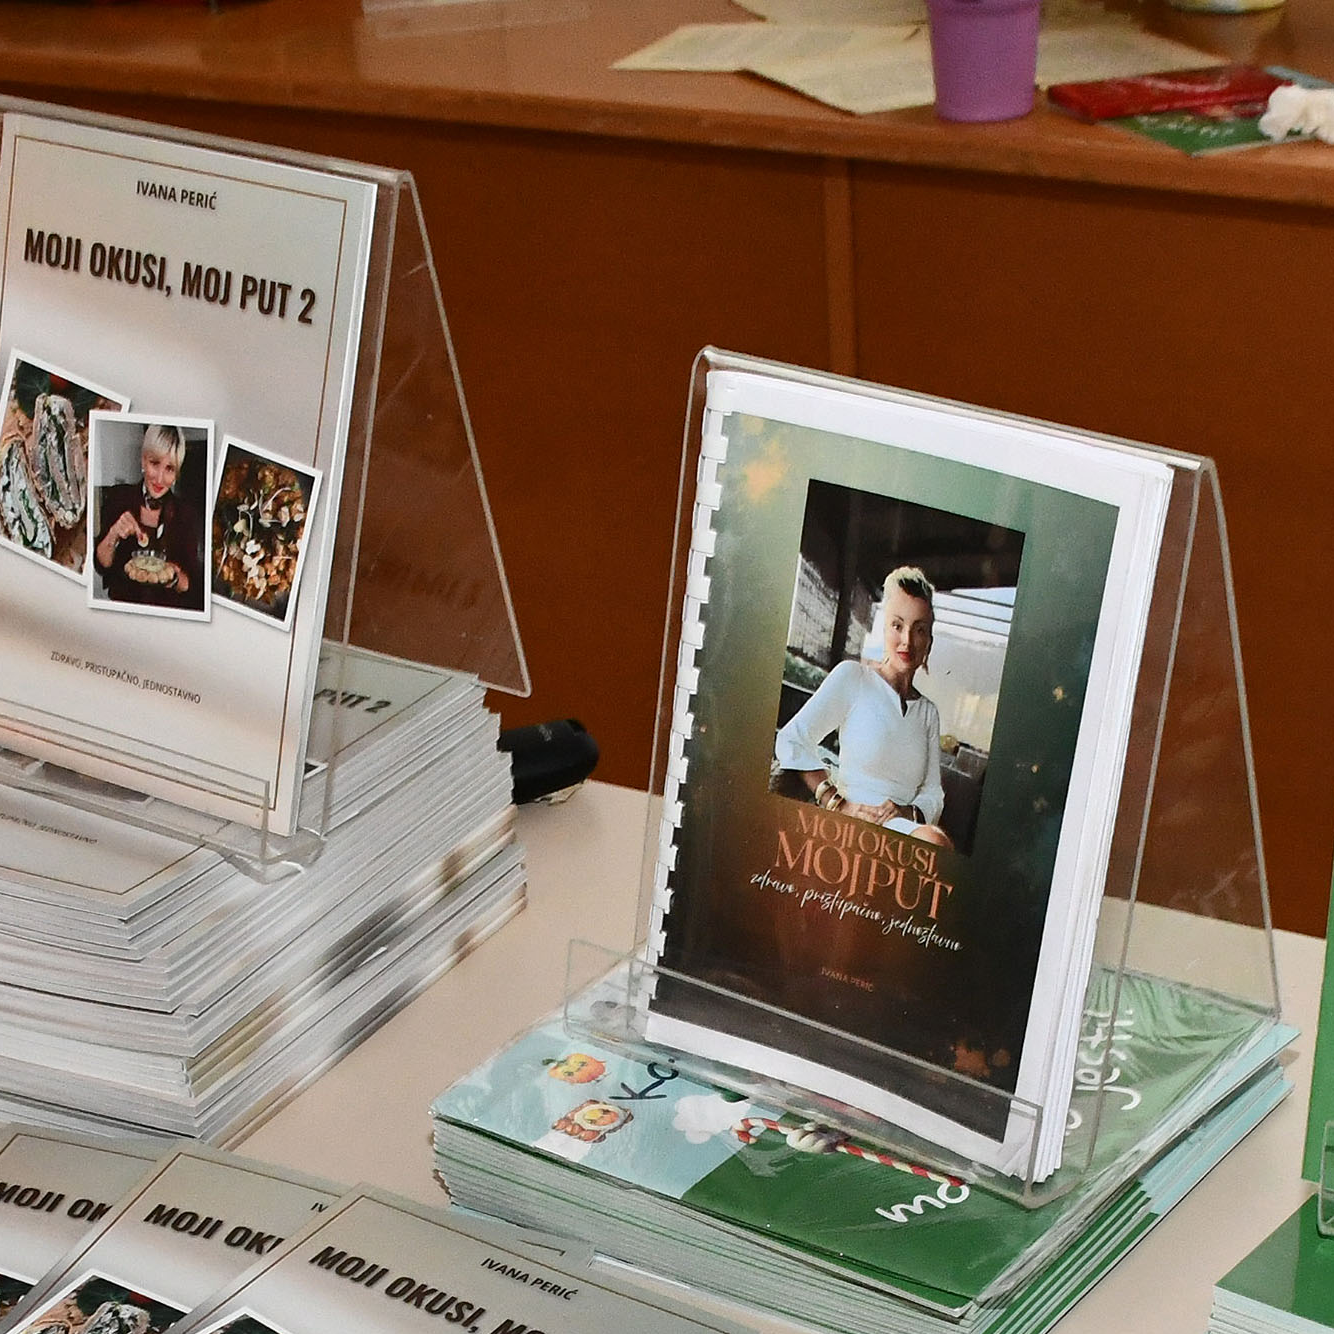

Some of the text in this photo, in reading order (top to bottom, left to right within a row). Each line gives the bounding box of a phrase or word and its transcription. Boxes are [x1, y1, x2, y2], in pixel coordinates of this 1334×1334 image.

[136, 180, 217, 210] IVANA PERIĆ
[23, 228, 316, 325] MOJI OKUSI, MOJ PUT 2
[50, 651, 83, 670] ZDRAVO,
[142, 679, 201, 704] JEDNOSTAVNO
[365, 700, 391, 713] 2
[795, 808, 855, 848] MOJI
[775, 830, 953, 919] MOJ PUT
[750, 869, 799, 898] zdravo,
[884, 913, 964, 951] jednostavno
[821, 967, 849, 985] IVANA
[143, 1204, 224, 1240] MOJI
[308, 1245, 389, 1289] MOJI
[384, 1275, 487, 1334] OKUSI,
[480, 1257, 579, 1301] IVANA PERIĆ
